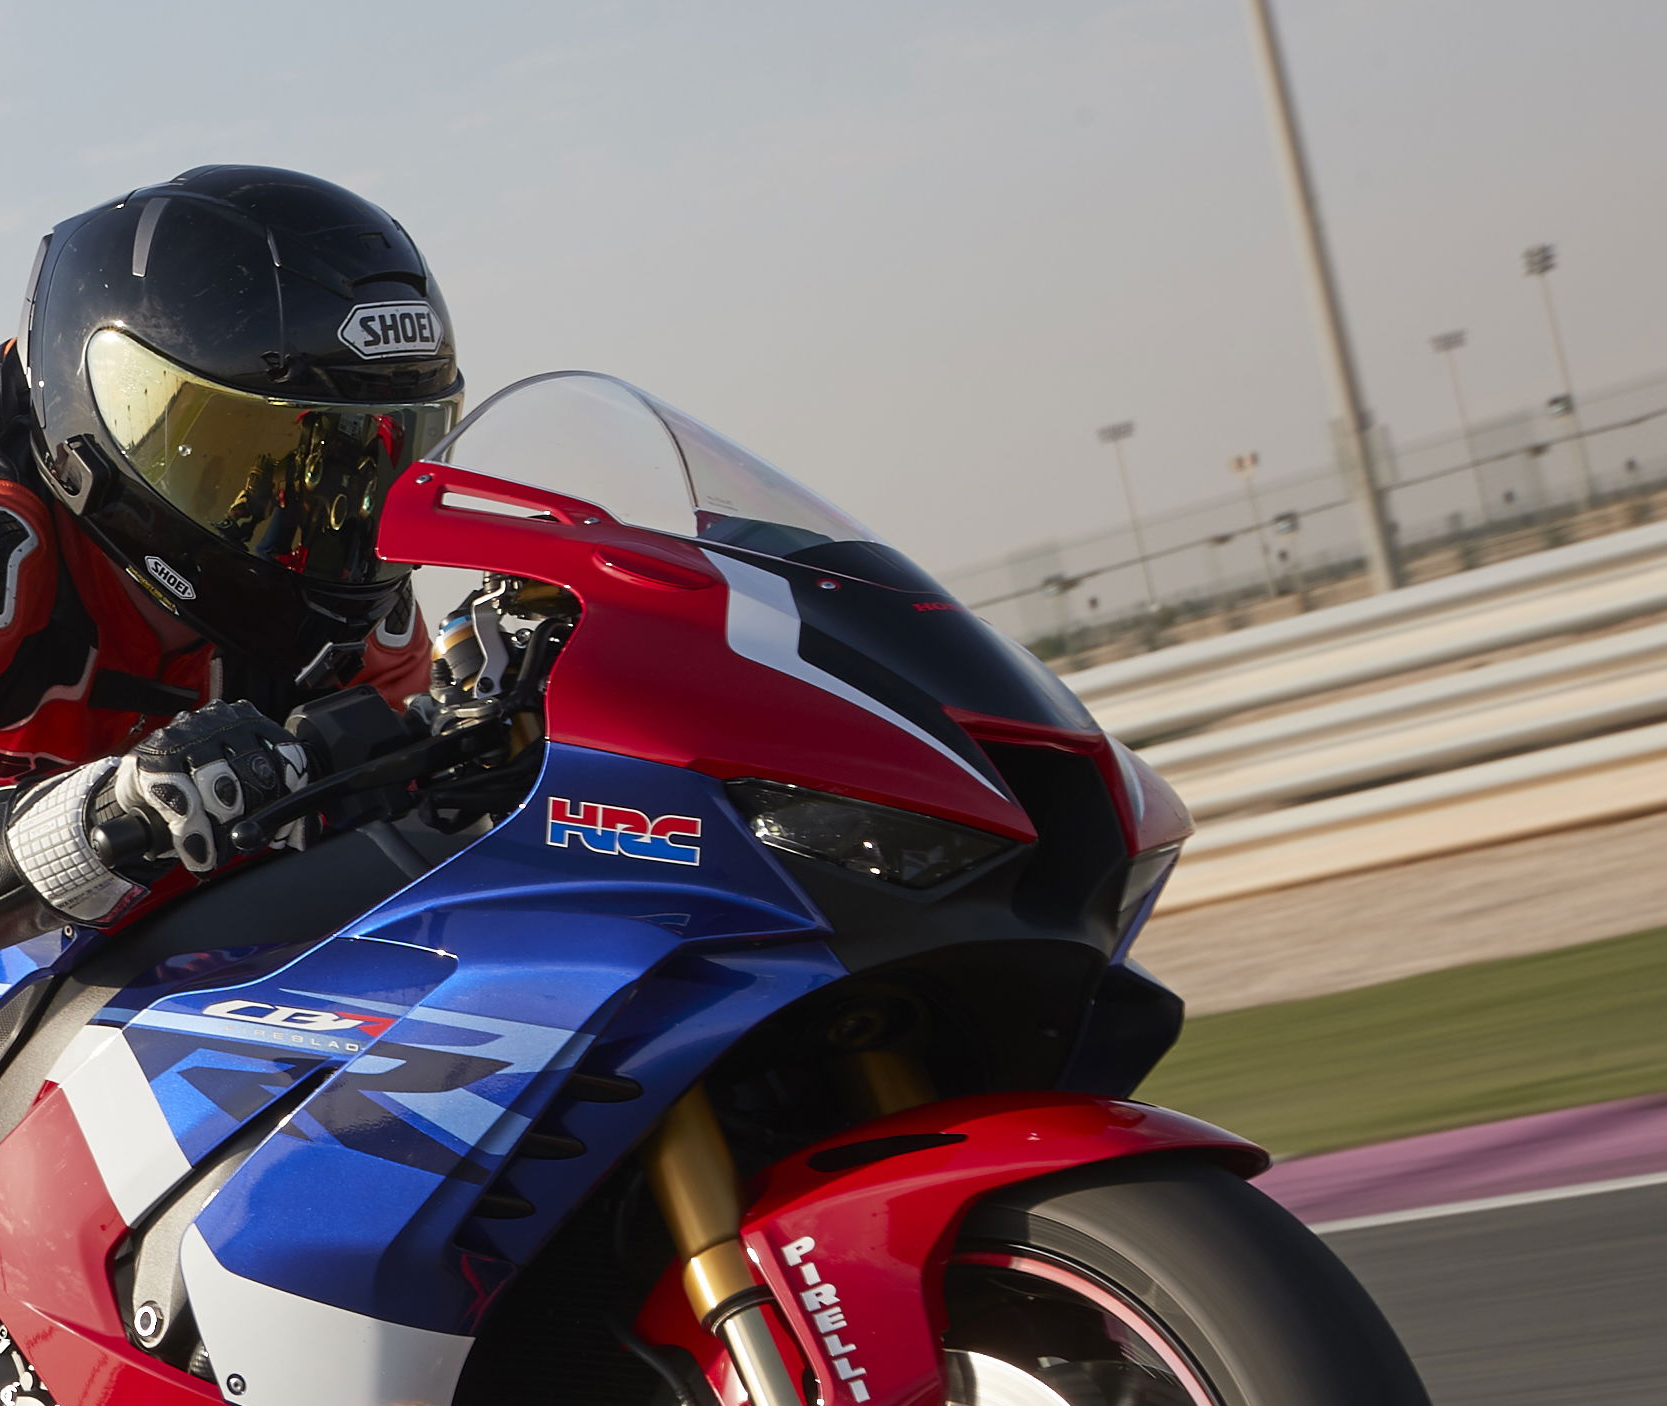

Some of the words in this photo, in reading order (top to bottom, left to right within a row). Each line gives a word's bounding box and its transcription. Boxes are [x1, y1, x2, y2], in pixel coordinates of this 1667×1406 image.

[359, 311, 435, 347] SHOEI
[151, 561, 189, 596] SHOEI
[546, 797, 702, 866] HRC
[223, 1024, 368, 1053] FIREBLAD
[781, 1236, 871, 1403] PIRELLI
